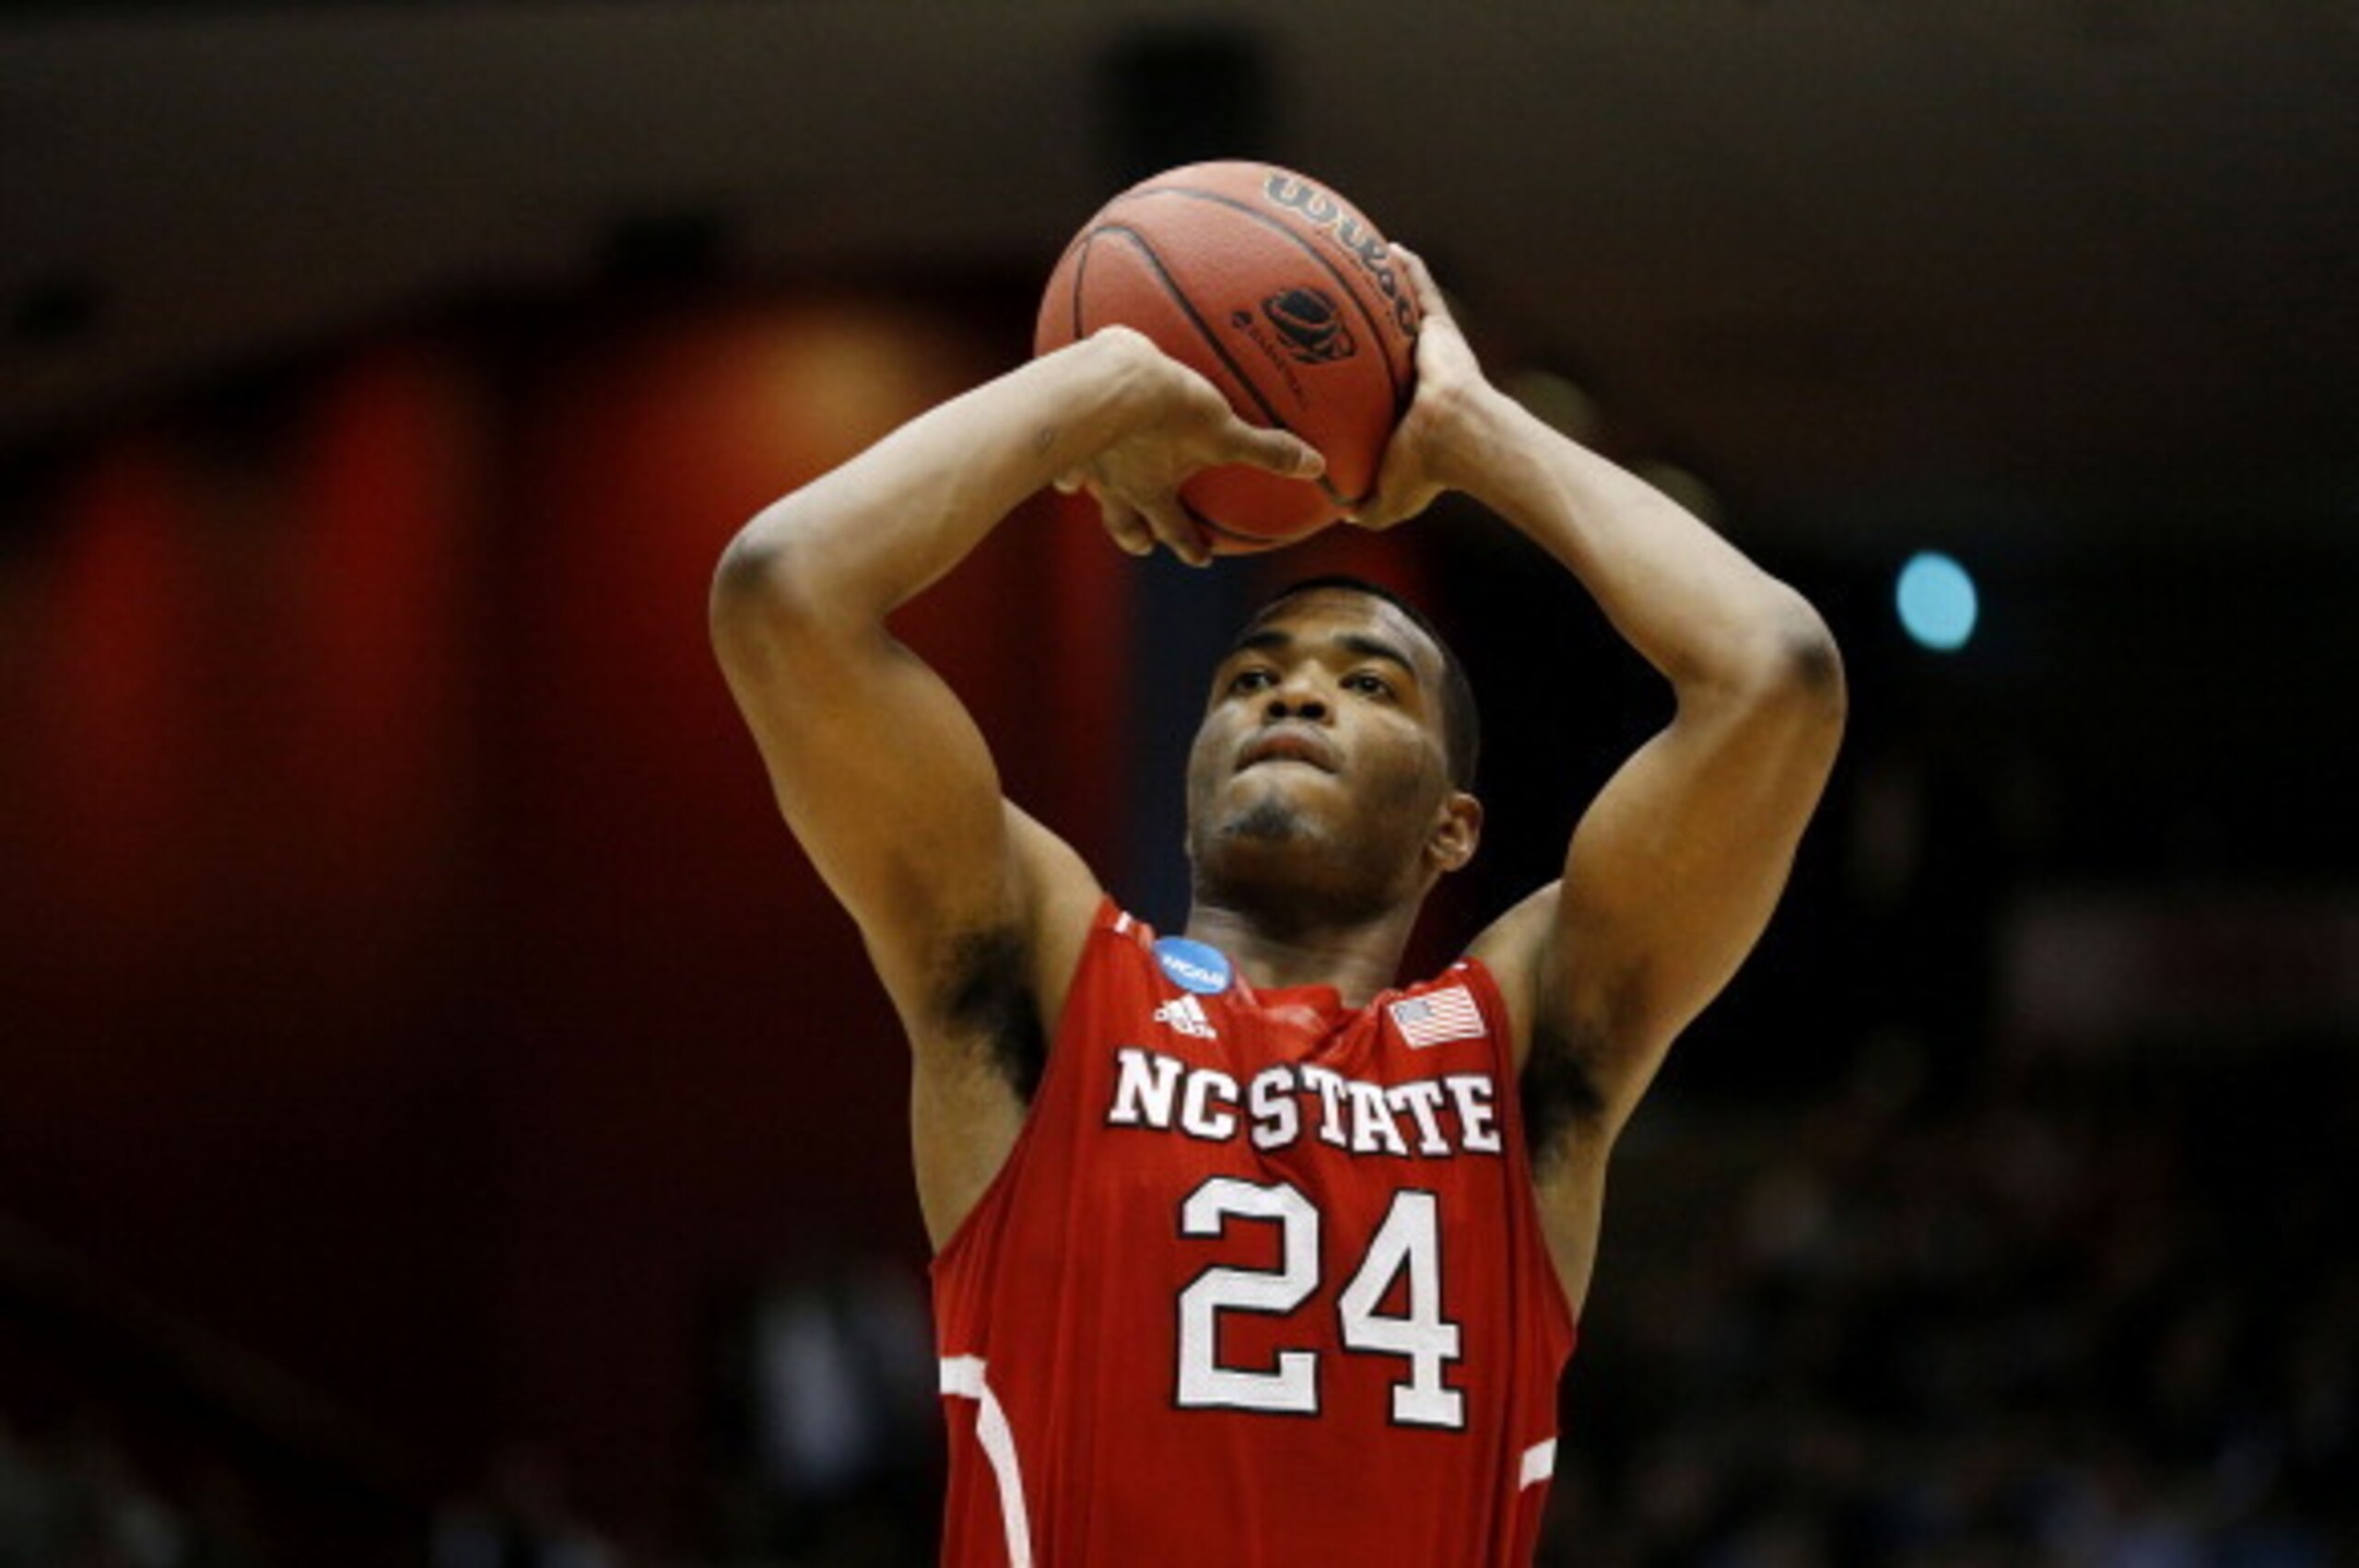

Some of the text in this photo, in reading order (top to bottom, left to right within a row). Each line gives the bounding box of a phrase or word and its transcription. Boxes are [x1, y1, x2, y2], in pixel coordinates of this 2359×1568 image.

[1263, 168, 1421, 337] Wilso
[1248, 1062, 1503, 1157] STATE
[1174, 1175, 1467, 1432] 24
